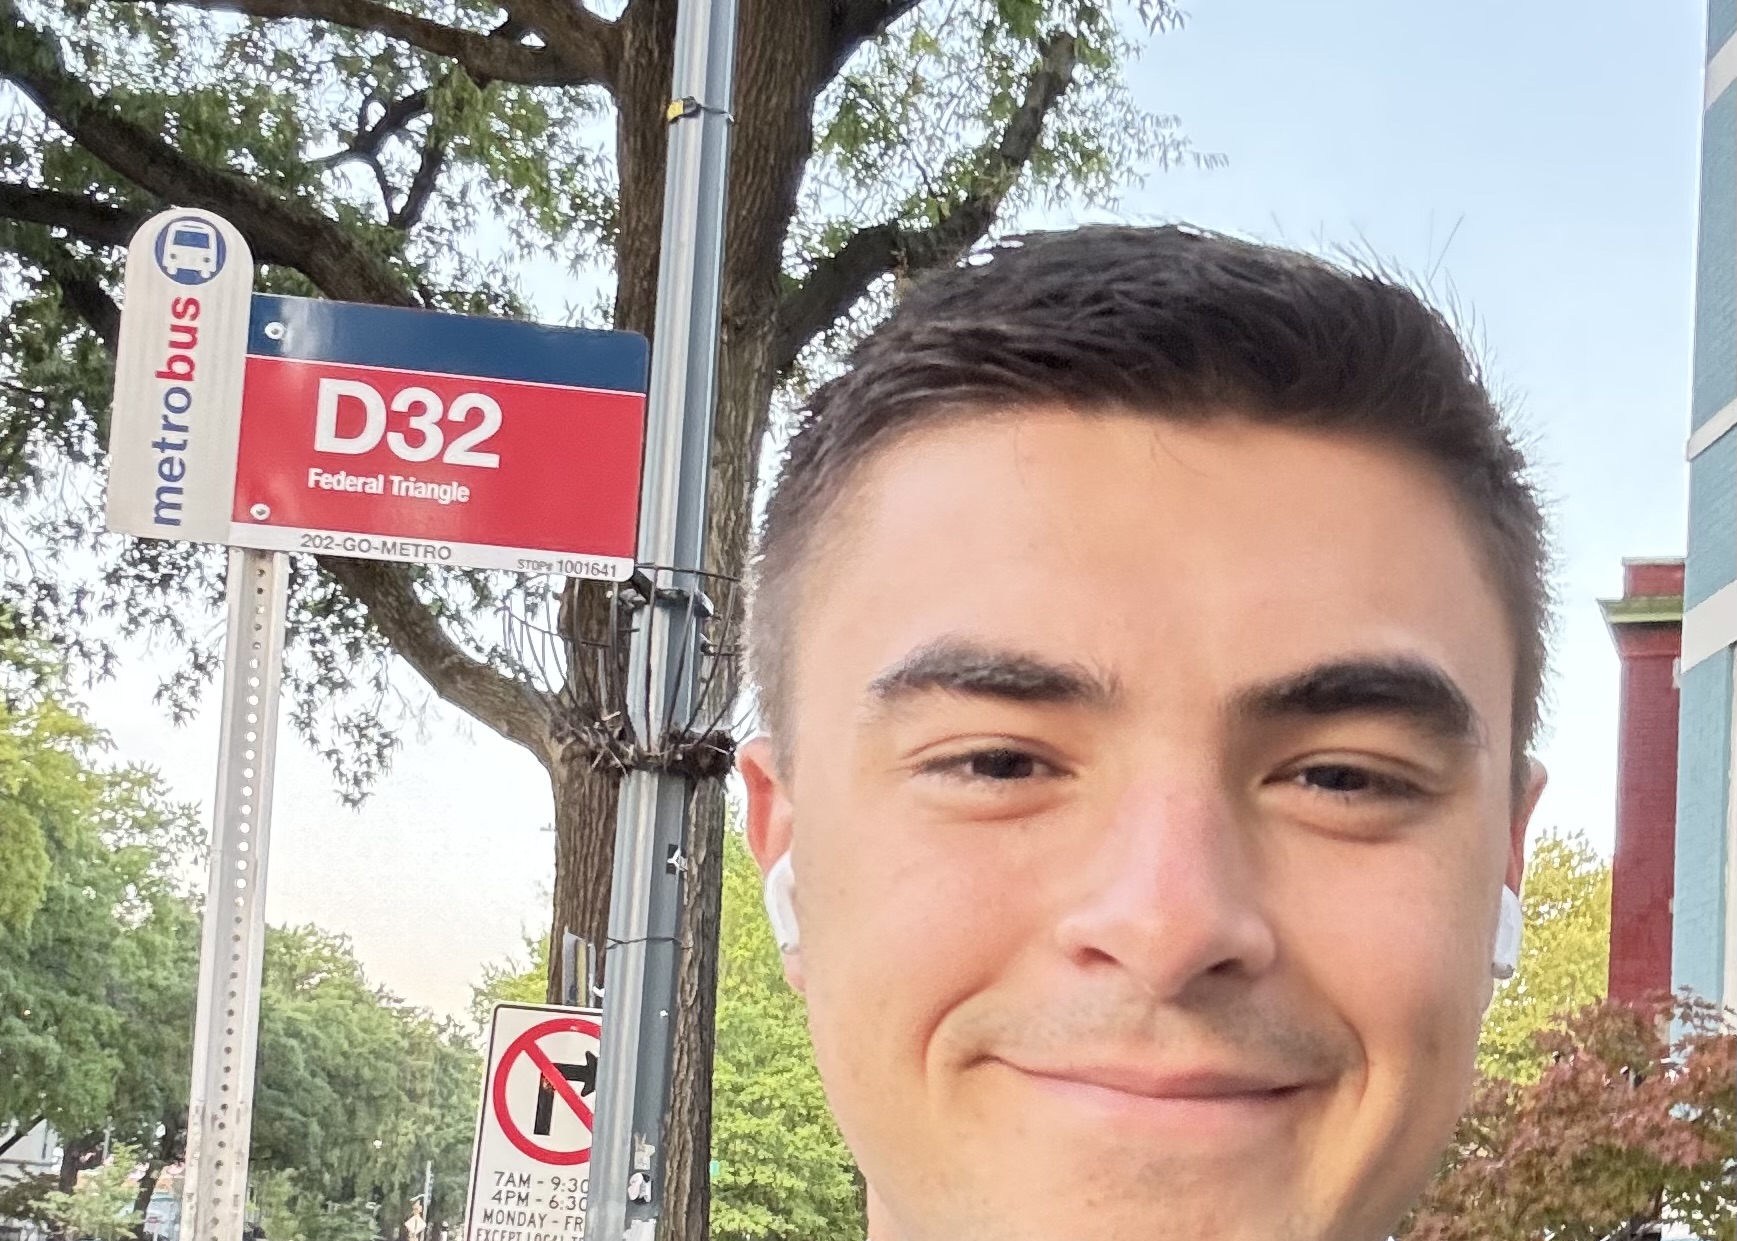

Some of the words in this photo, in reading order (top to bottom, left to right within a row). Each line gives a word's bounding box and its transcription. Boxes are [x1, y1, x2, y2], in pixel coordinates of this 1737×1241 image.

[151, 297, 200, 526] metrobus
[314, 377, 503, 469] D32
[308, 467, 385, 495] Federal
[389, 475, 471, 505] Triangle
[300, 533, 452, 561] 202-GO-METRO
[556, 559, 617, 578] 1001641
[494, 1170, 532, 1189] 7AM
[491, 1189, 530, 1207] 4PM
[482, 1208, 548, 1229] MONDAY
[564, 1215, 584, 1232] FR
